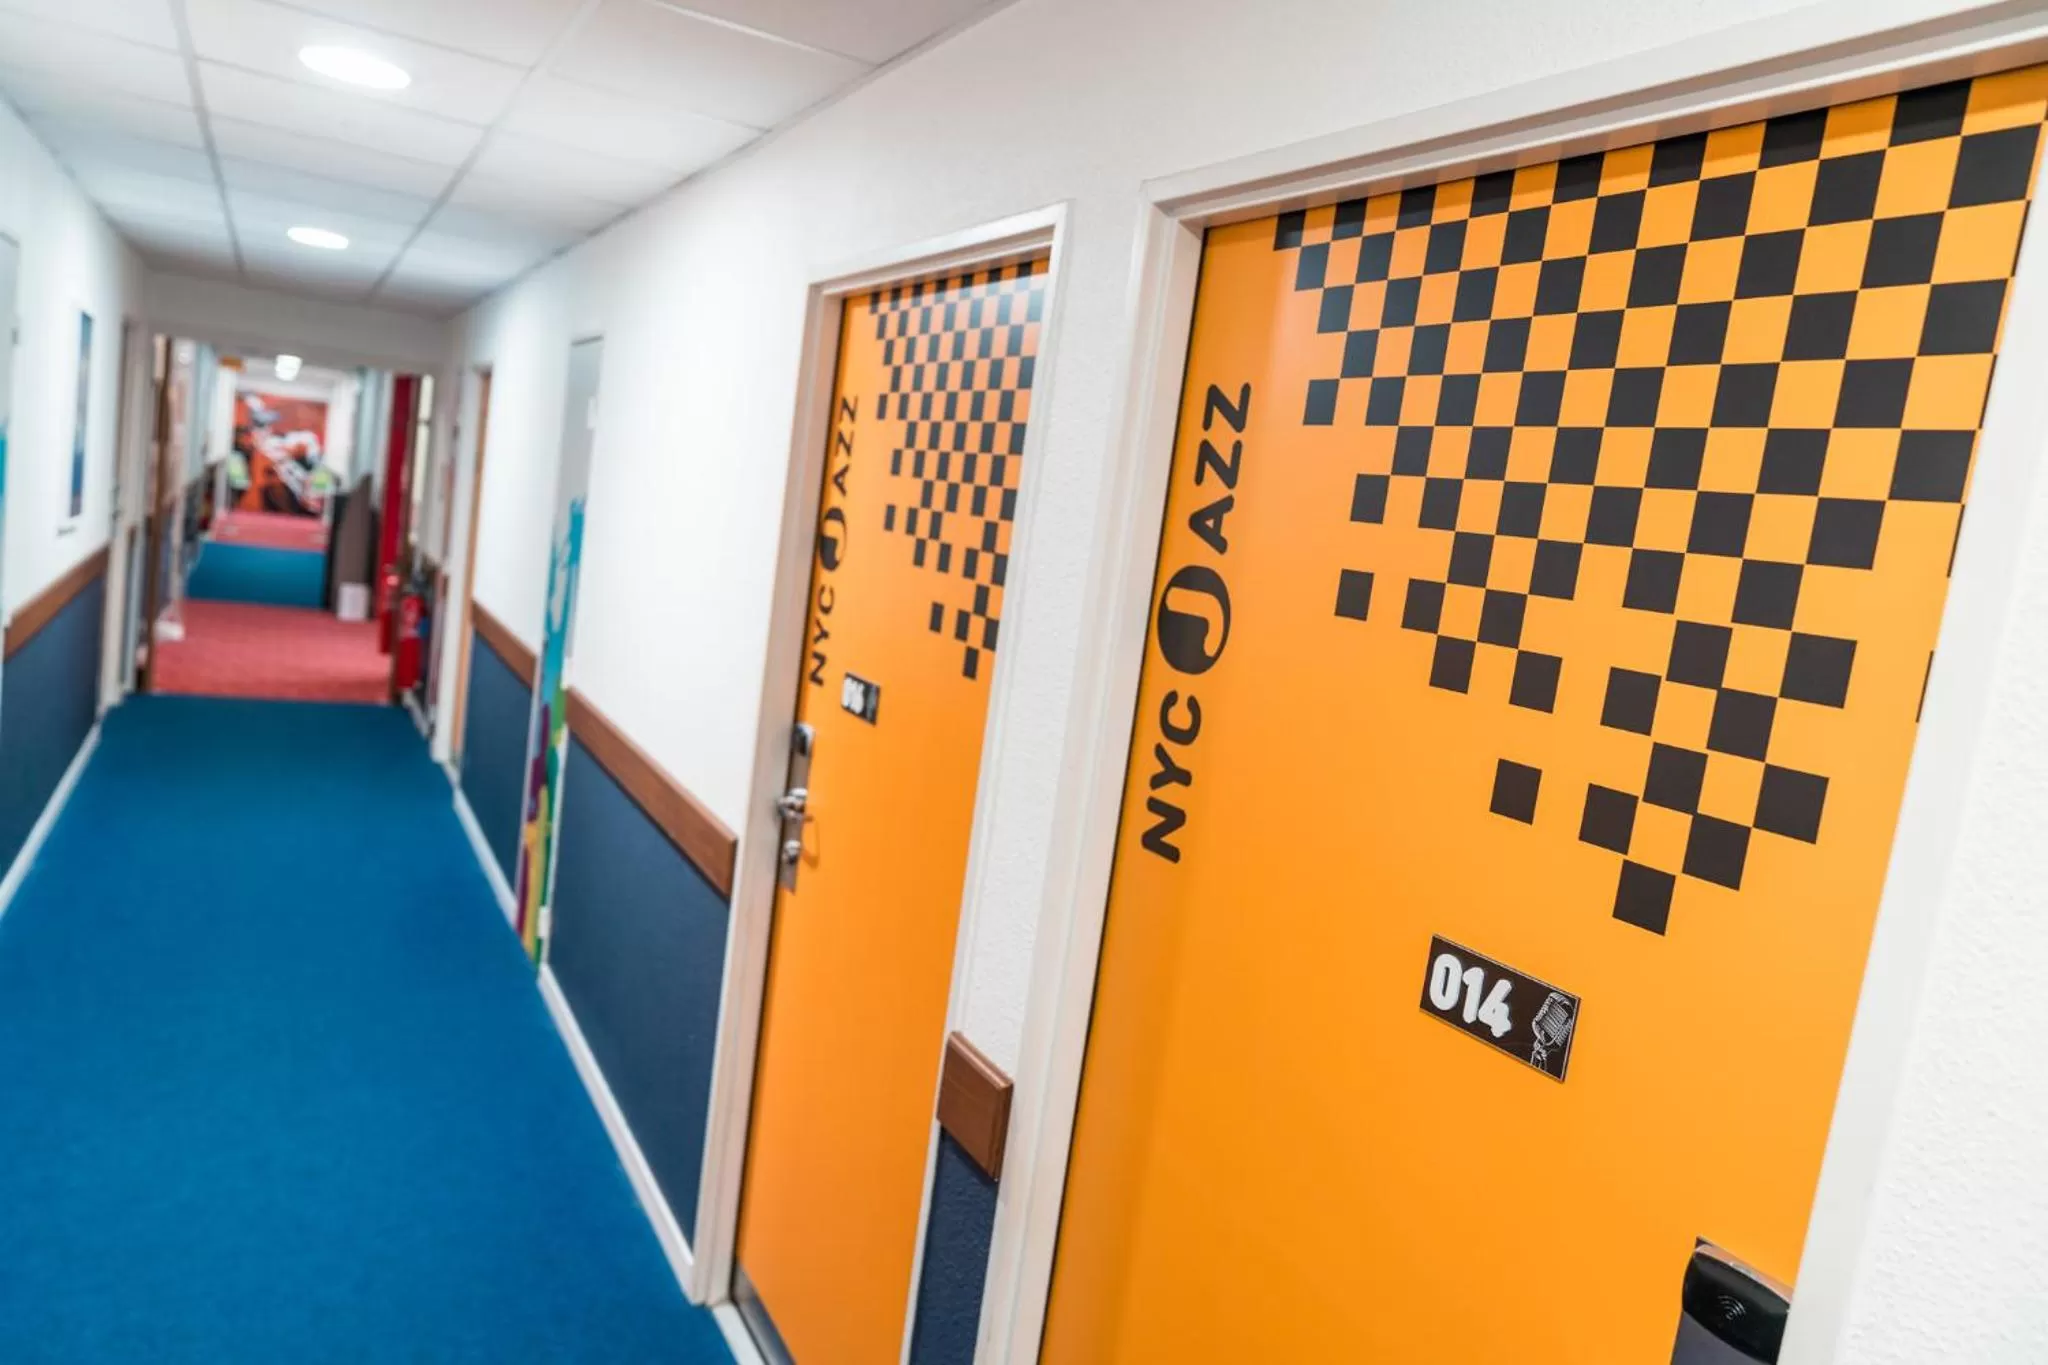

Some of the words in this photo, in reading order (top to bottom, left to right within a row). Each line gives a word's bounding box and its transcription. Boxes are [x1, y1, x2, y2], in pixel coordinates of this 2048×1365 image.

[818, 394, 859, 573] JAZZ
[1157, 383, 1251, 675] JAZZ
[808, 584, 836, 687] NYC
[1141, 691, 1201, 863] NYC
[1429, 953, 1513, 1038] 014
